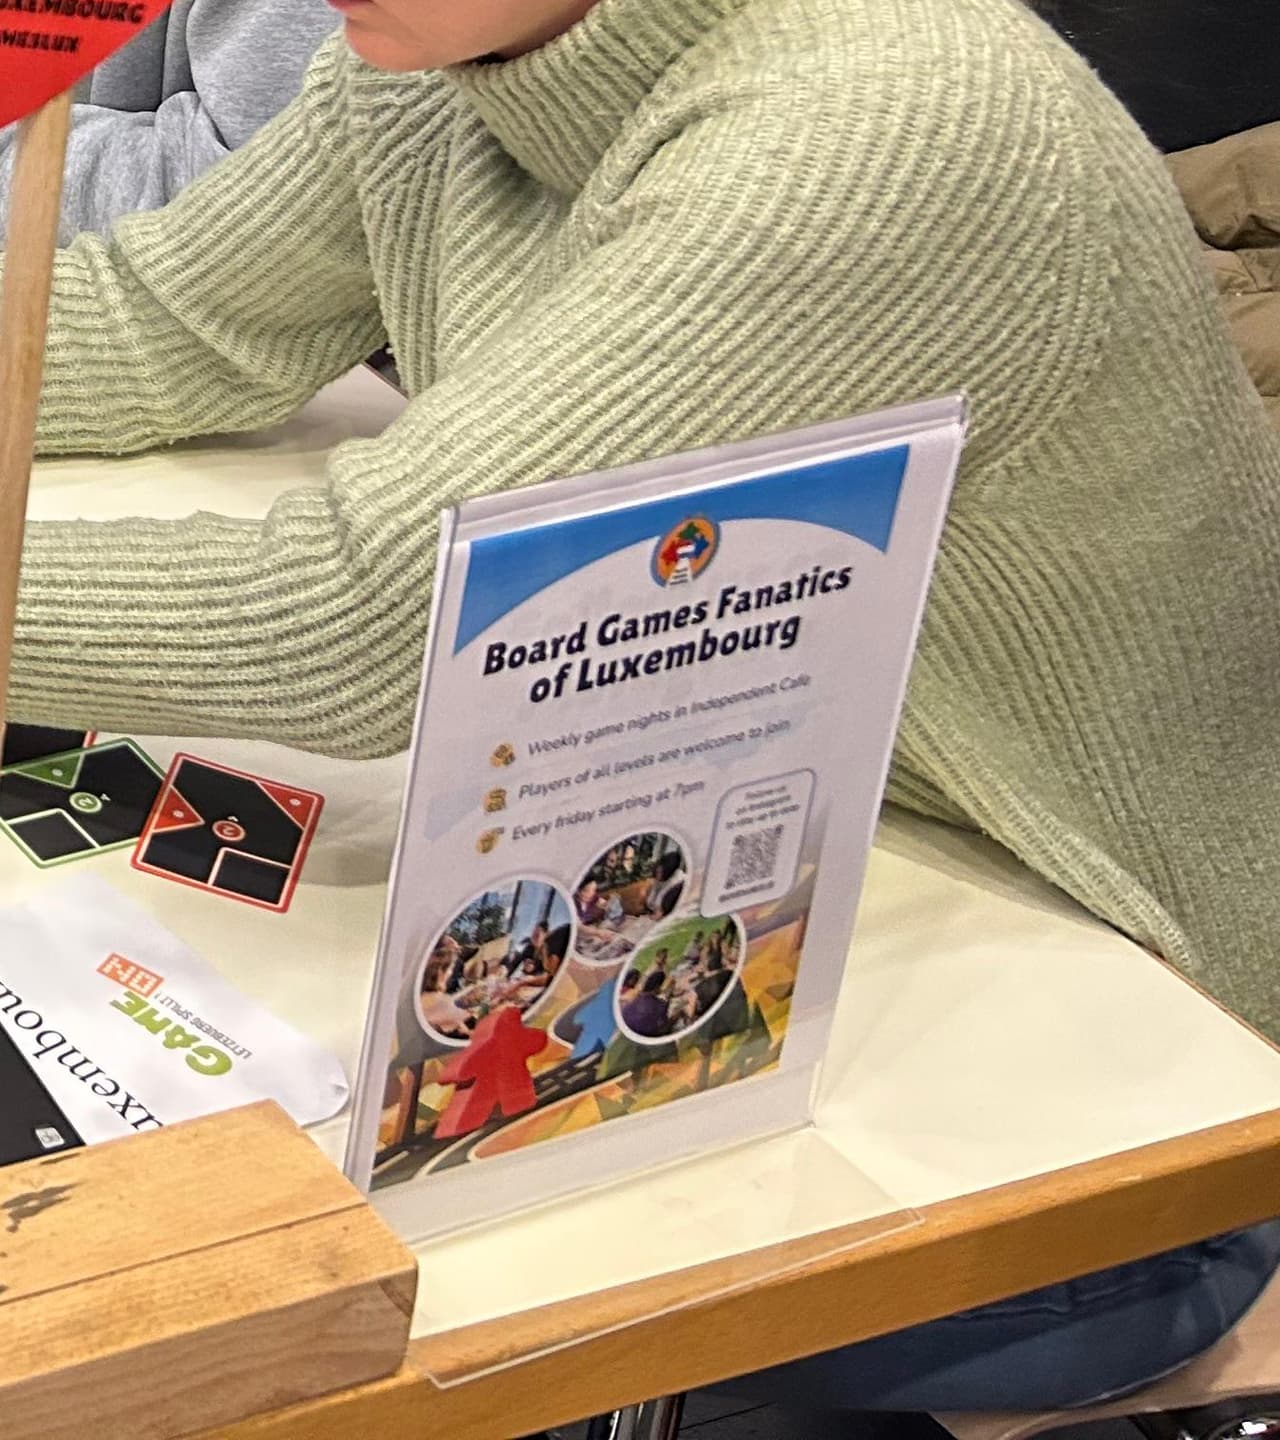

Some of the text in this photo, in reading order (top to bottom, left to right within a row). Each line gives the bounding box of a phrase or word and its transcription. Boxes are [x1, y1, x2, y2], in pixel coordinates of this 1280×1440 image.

[483, 566, 853, 676] Board Games Fanatics
[529, 615, 801, 703] of Luxembourg
[518, 775, 572, 800] Players
[575, 770, 591, 785] of
[593, 763, 611, 781] all
[658, 748, 682, 764] are
[684, 730, 747, 757] welcome
[764, 720, 792, 737] join
[528, 732, 588, 757] Weekly
[583, 721, 625, 744] game
[628, 709, 672, 732] nights
[674, 705, 689, 719] in
[690, 682, 778, 714] Independent
[512, 822, 552, 841] Every
[554, 810, 595, 830] friday
[598, 794, 653, 817] starting
[656, 789, 672, 803] at
[109, 990, 233, 1076] GAME
